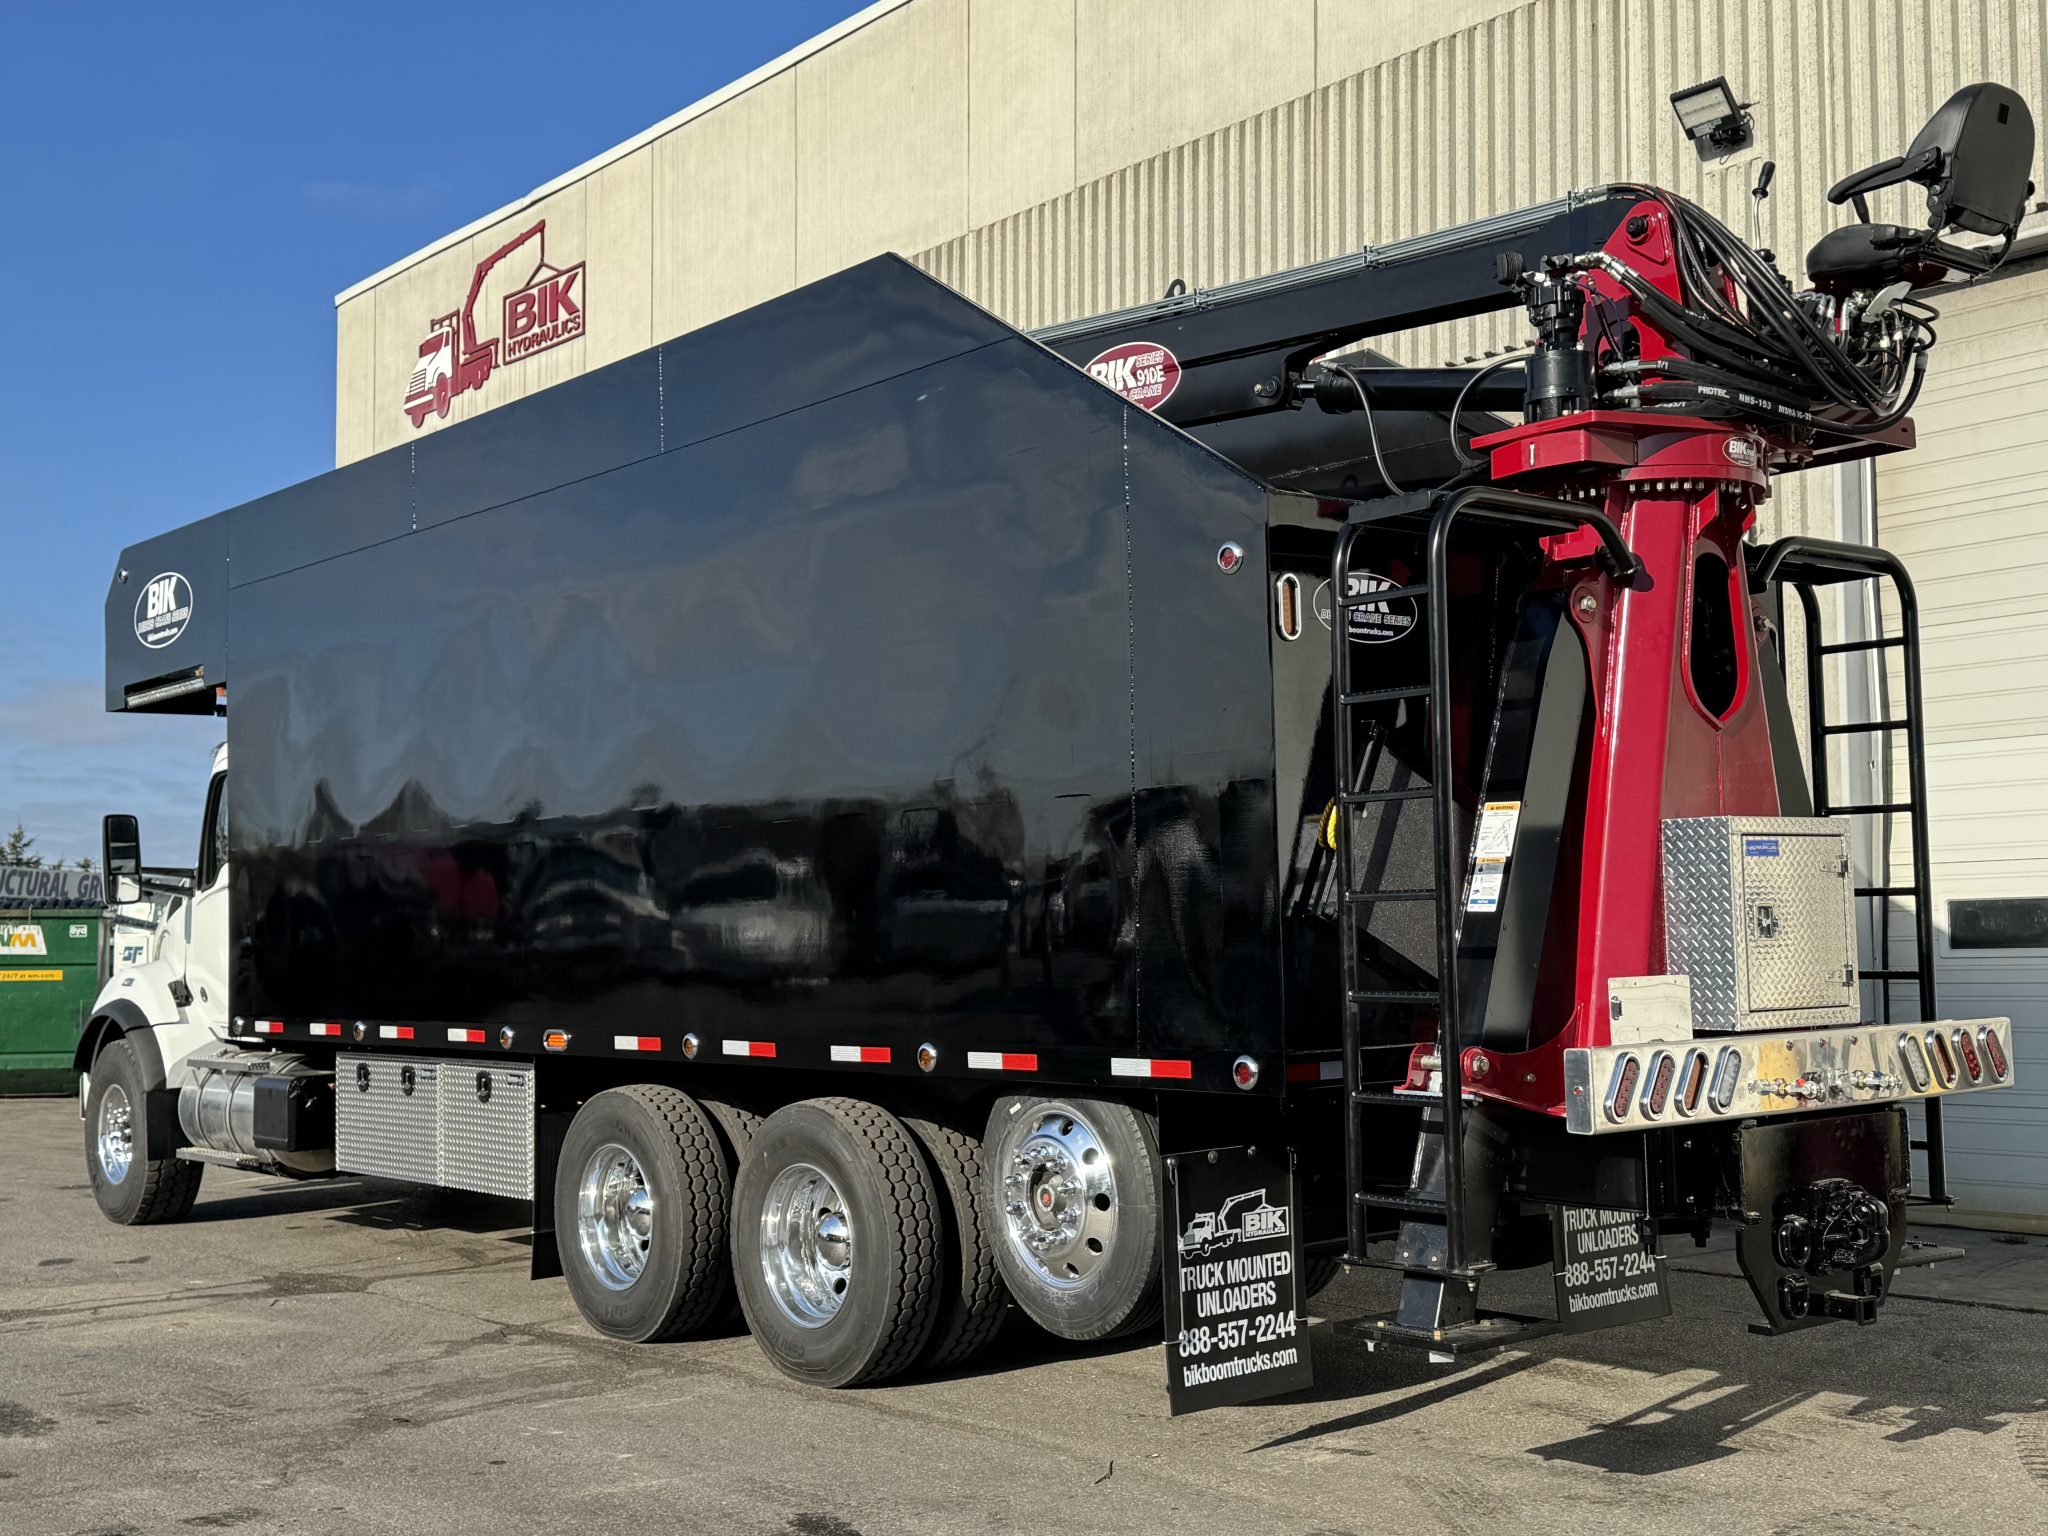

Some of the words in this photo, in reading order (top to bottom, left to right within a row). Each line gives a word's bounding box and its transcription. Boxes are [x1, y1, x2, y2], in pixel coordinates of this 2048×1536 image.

[508, 271, 580, 340] BIK
[507, 314, 580, 358] HYDRAULICS
[1090, 355, 1138, 391] BIK
[1136, 350, 1165, 368] SERIES
[1128, 383, 1163, 401] CRANE
[1738, 393, 1772, 410] NHS-153
[1729, 440, 1748, 455] BIK
[146, 575, 178, 619] BIK
[1348, 625, 1394, 637] boomtrucks.com
[1352, 611, 1382, 624] CRANE
[1383, 614, 1412, 627] SERIES
[77, 874, 104, 899] GR
[1244, 1209, 1285, 1232] BIK
[1565, 1207, 1599, 1233] TRUCK
[1600, 1209, 1636, 1226] MOUN
[1577, 1223, 1639, 1255] UNLOADERS
[1180, 1260, 1223, 1293] TRUCK
[1227, 1250, 1291, 1285] MOUNTED
[1564, 1250, 1656, 1288] 888-557-2244
[1196, 1280, 1277, 1318] UNLOADERS
[1568, 1280, 1659, 1313] bikboomtrucks.com
[1178, 1310, 1297, 1358] 888-557-2244
[1183, 1346, 1298, 1388] bikboomtrucks.com
